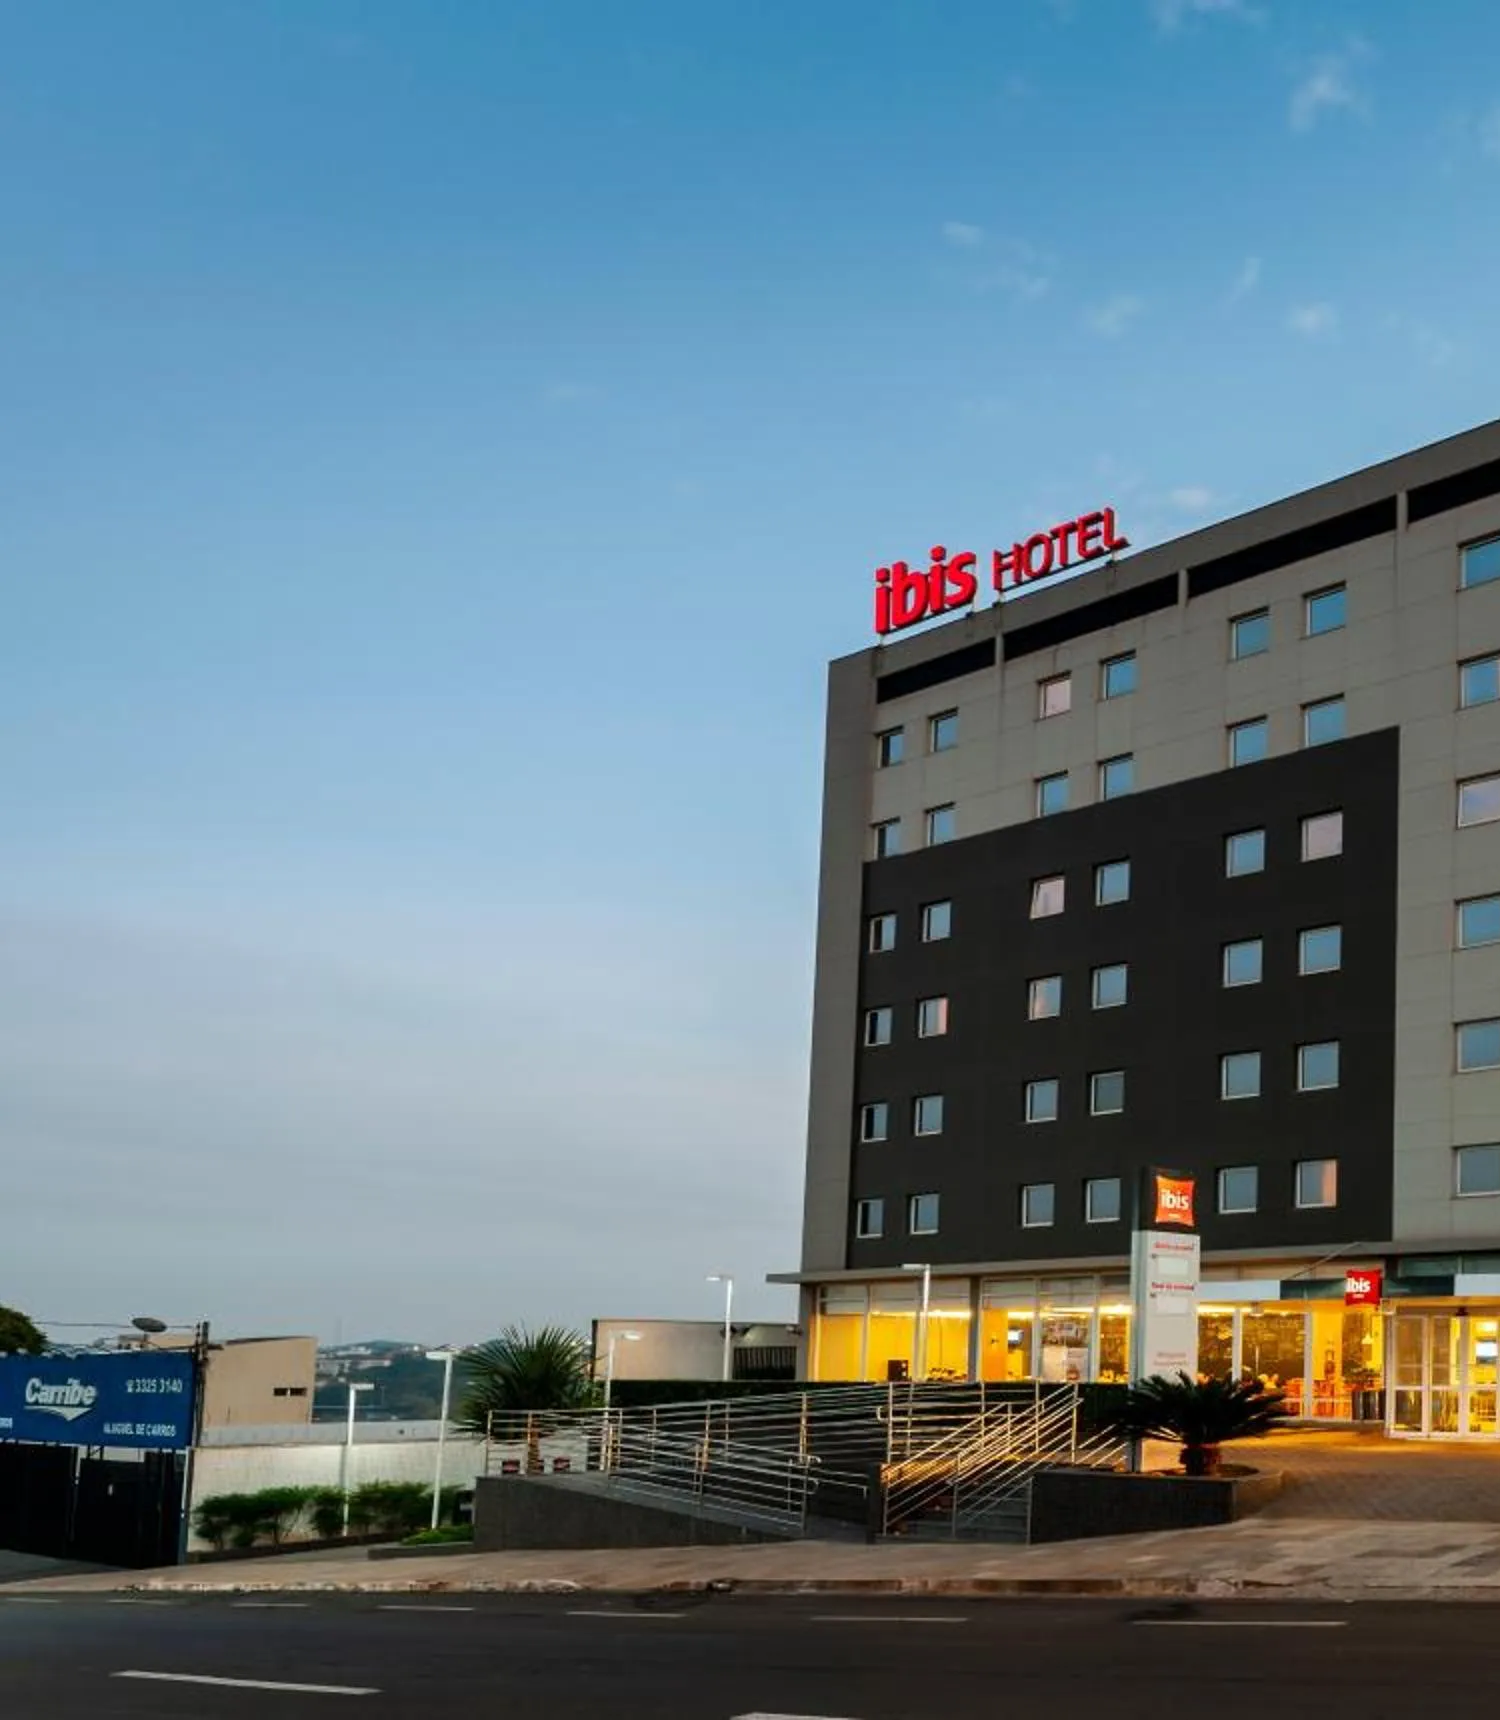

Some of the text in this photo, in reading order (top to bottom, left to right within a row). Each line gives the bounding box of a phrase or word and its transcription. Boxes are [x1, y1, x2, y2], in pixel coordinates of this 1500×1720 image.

[875, 507, 1129, 634] ibis HOTEL
[1161, 1188, 1190, 1211] ibis
[1346, 1277, 1371, 1293] ibis
[25, 1377, 97, 1405] Carribe
